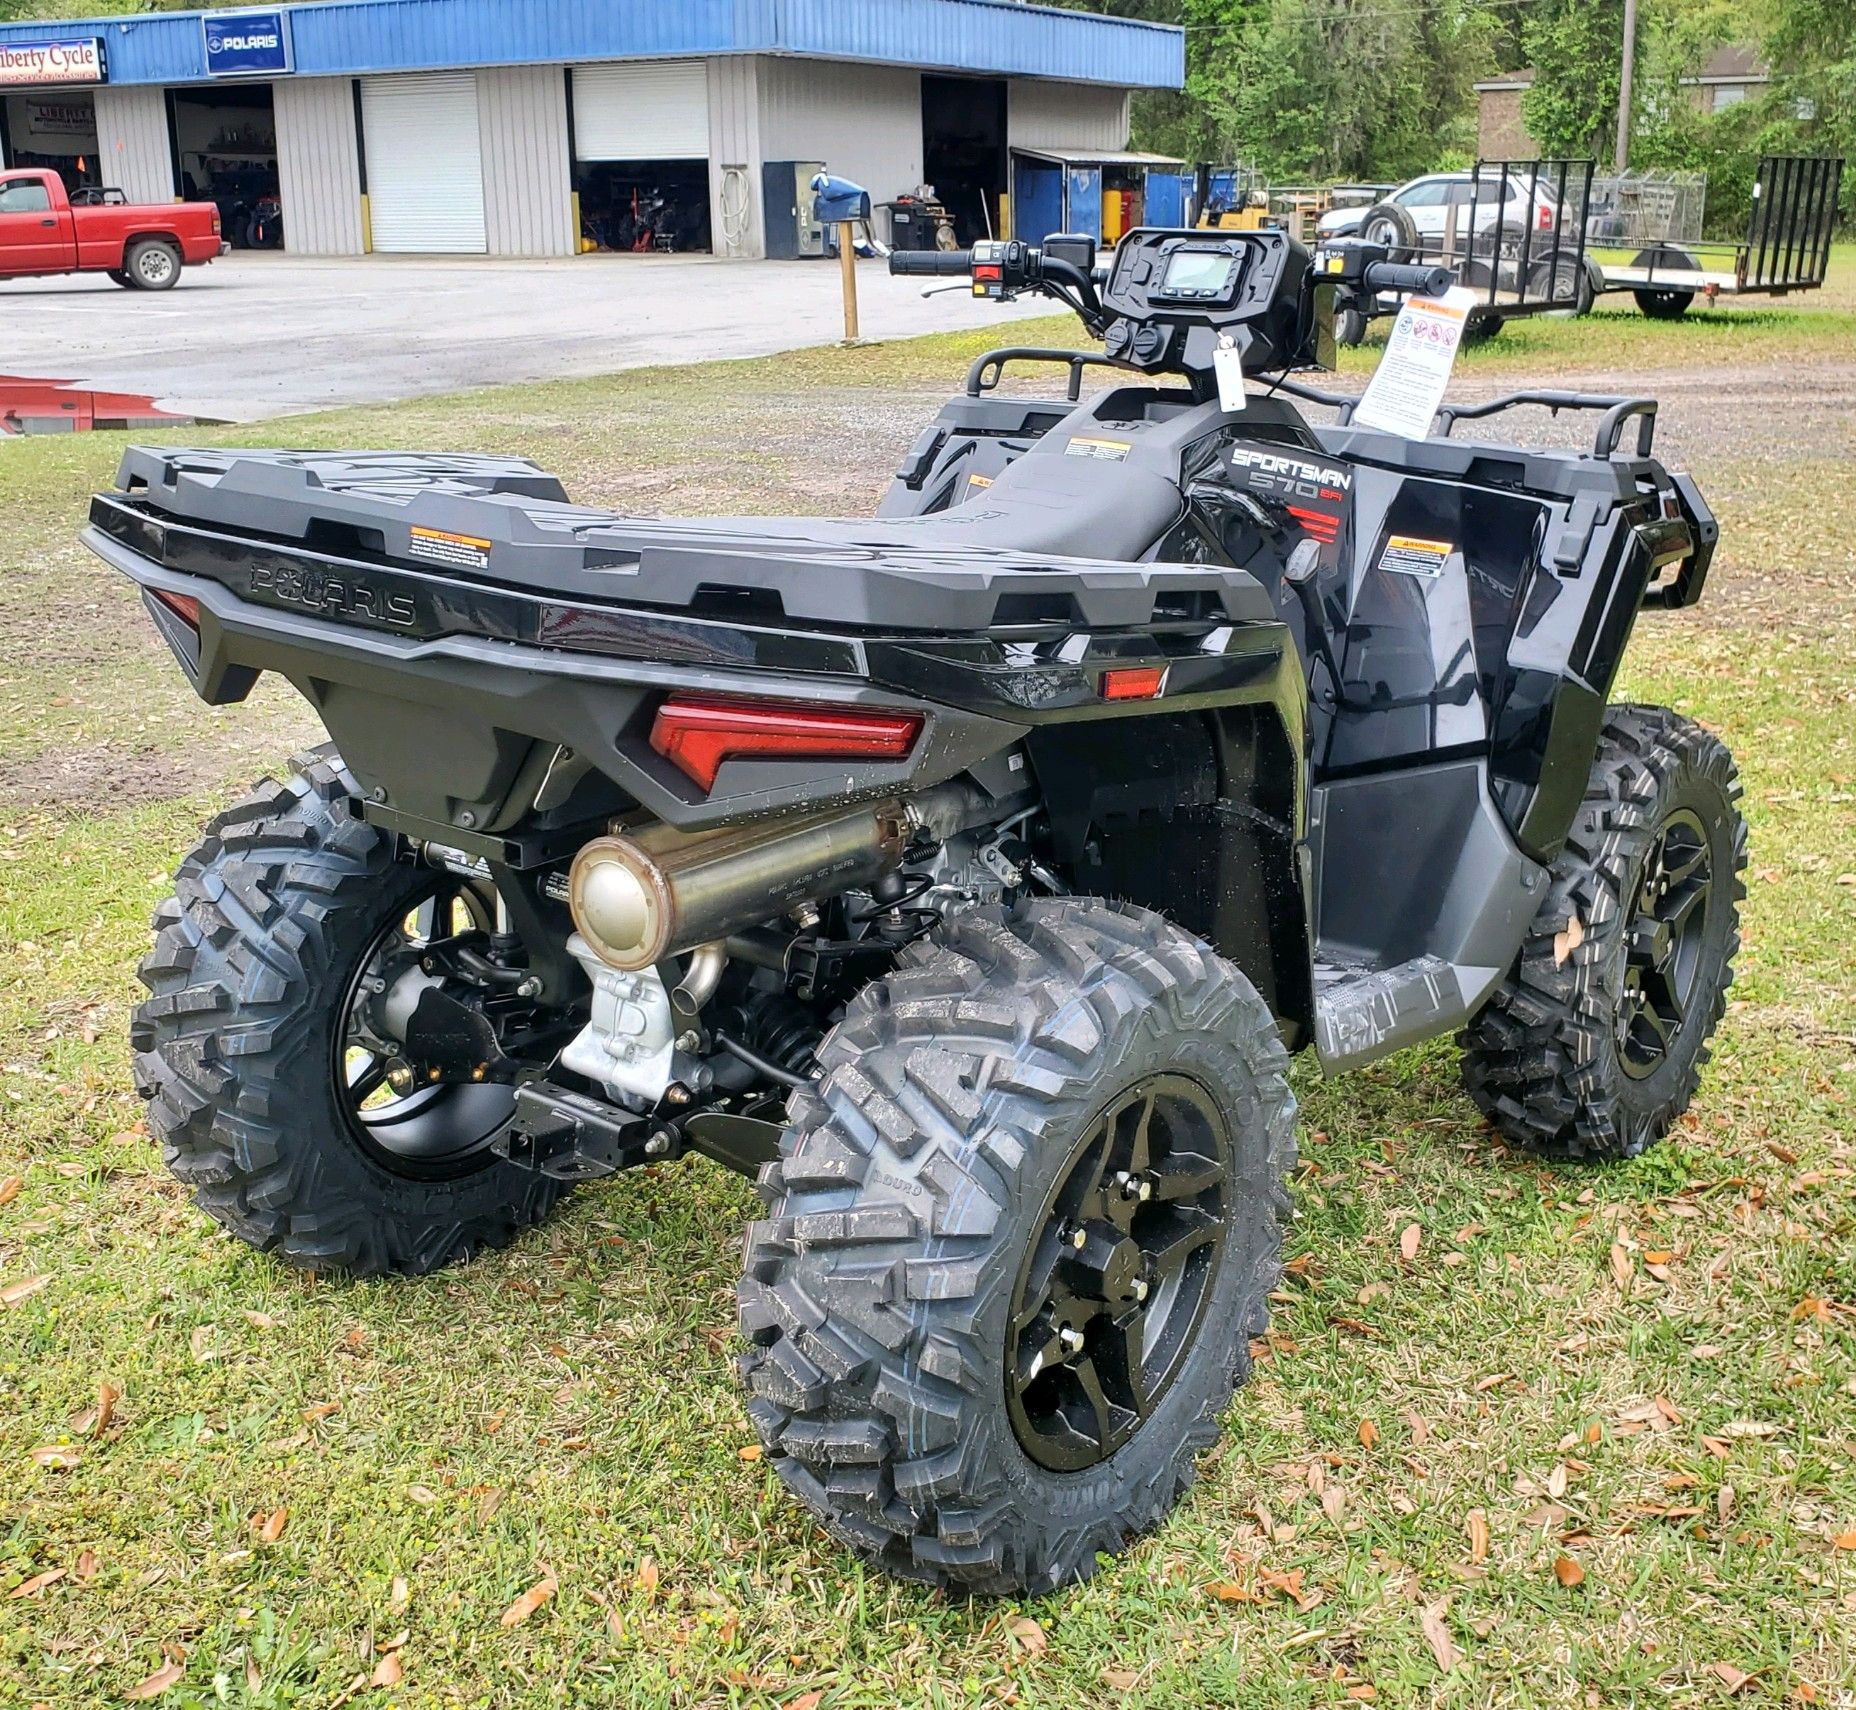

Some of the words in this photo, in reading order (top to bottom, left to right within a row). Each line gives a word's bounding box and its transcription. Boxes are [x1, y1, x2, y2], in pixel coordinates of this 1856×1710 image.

[223, 35, 278, 50] POLARIS
[0, 45, 45, 73] iberty
[49, 43, 93, 72] Cycle
[1231, 448, 1352, 490] SPORTSMAN
[1248, 471, 1319, 499] 570
[1319, 487, 1343, 502] EFI
[251, 562, 416, 626] POLARIS
[545, 885, 570, 898] POLAR
